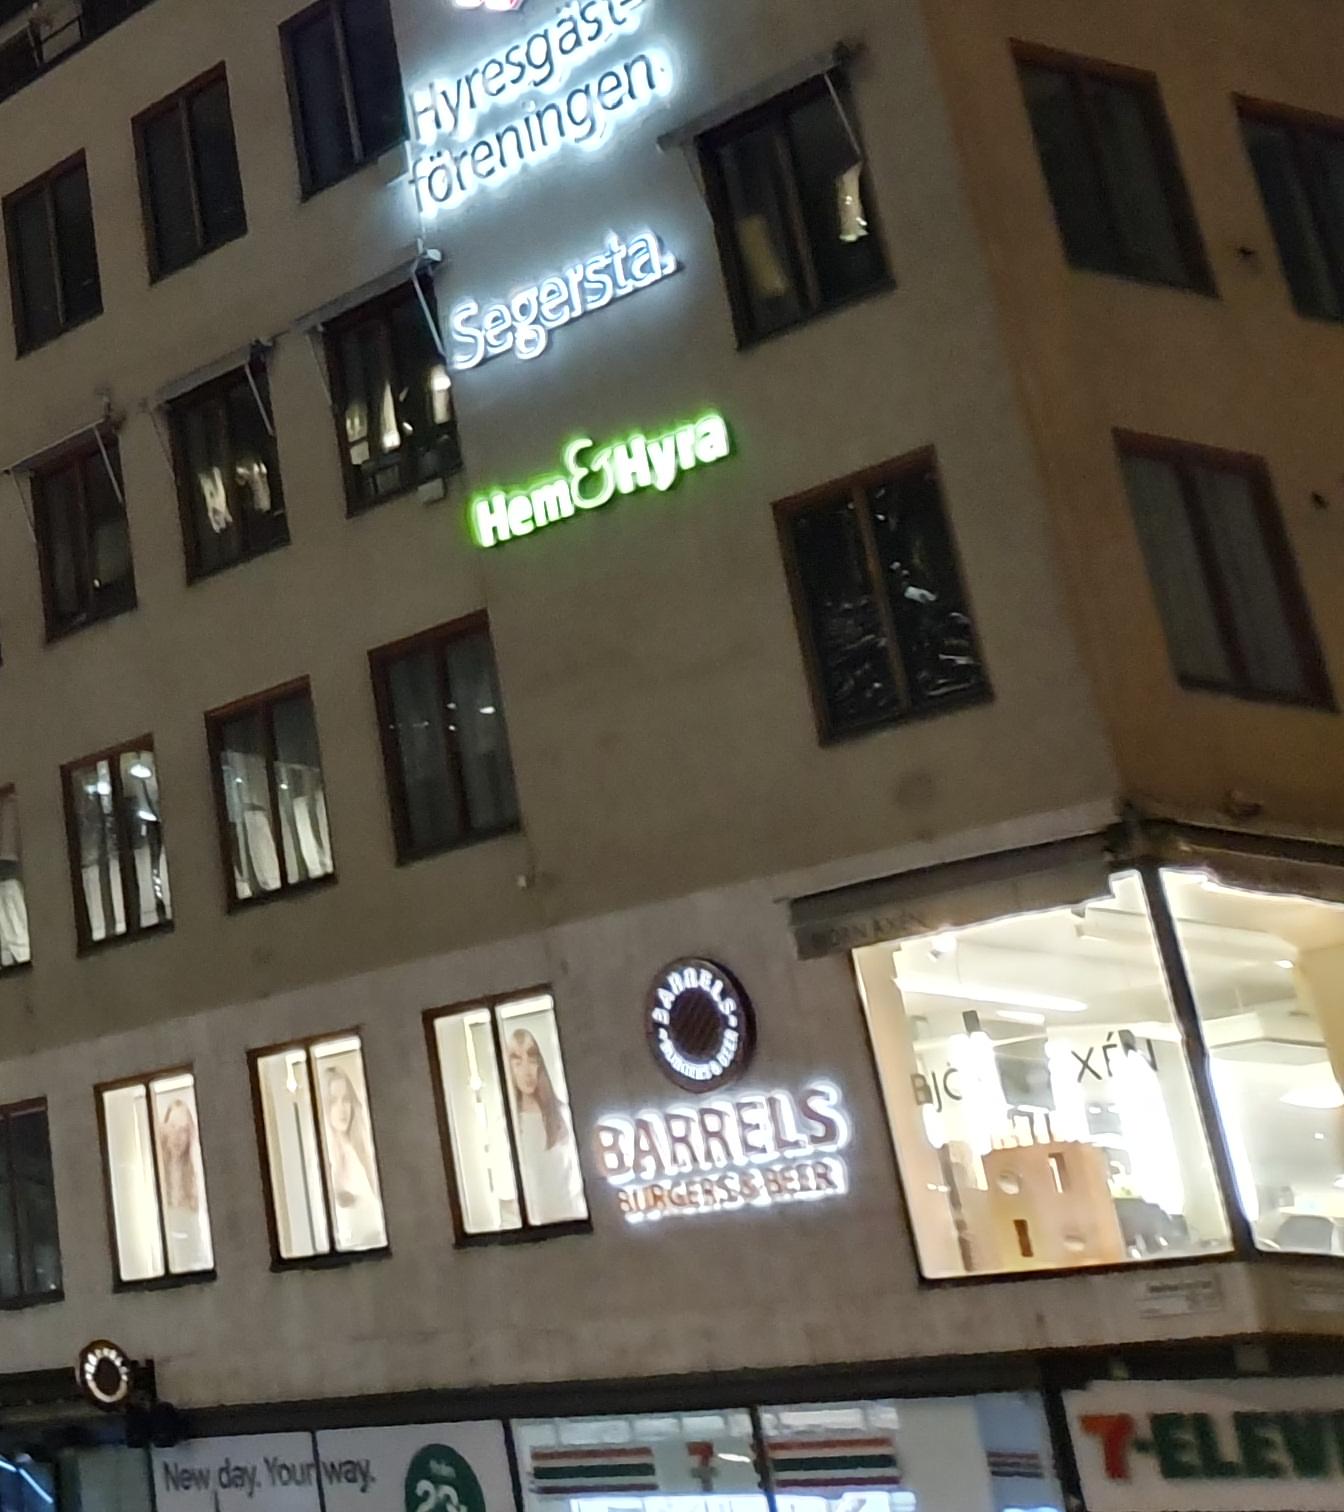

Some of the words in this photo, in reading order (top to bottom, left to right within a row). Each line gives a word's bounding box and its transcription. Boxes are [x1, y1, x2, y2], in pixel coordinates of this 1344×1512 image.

[409, 54, 656, 212] föreningen
[597, 1088, 842, 1179] BARRELS
[164, 1461, 210, 1491] New
[218, 1457, 261, 1498] day.
[262, 1456, 316, 1488] Your
[321, 1458, 376, 1494] way.
